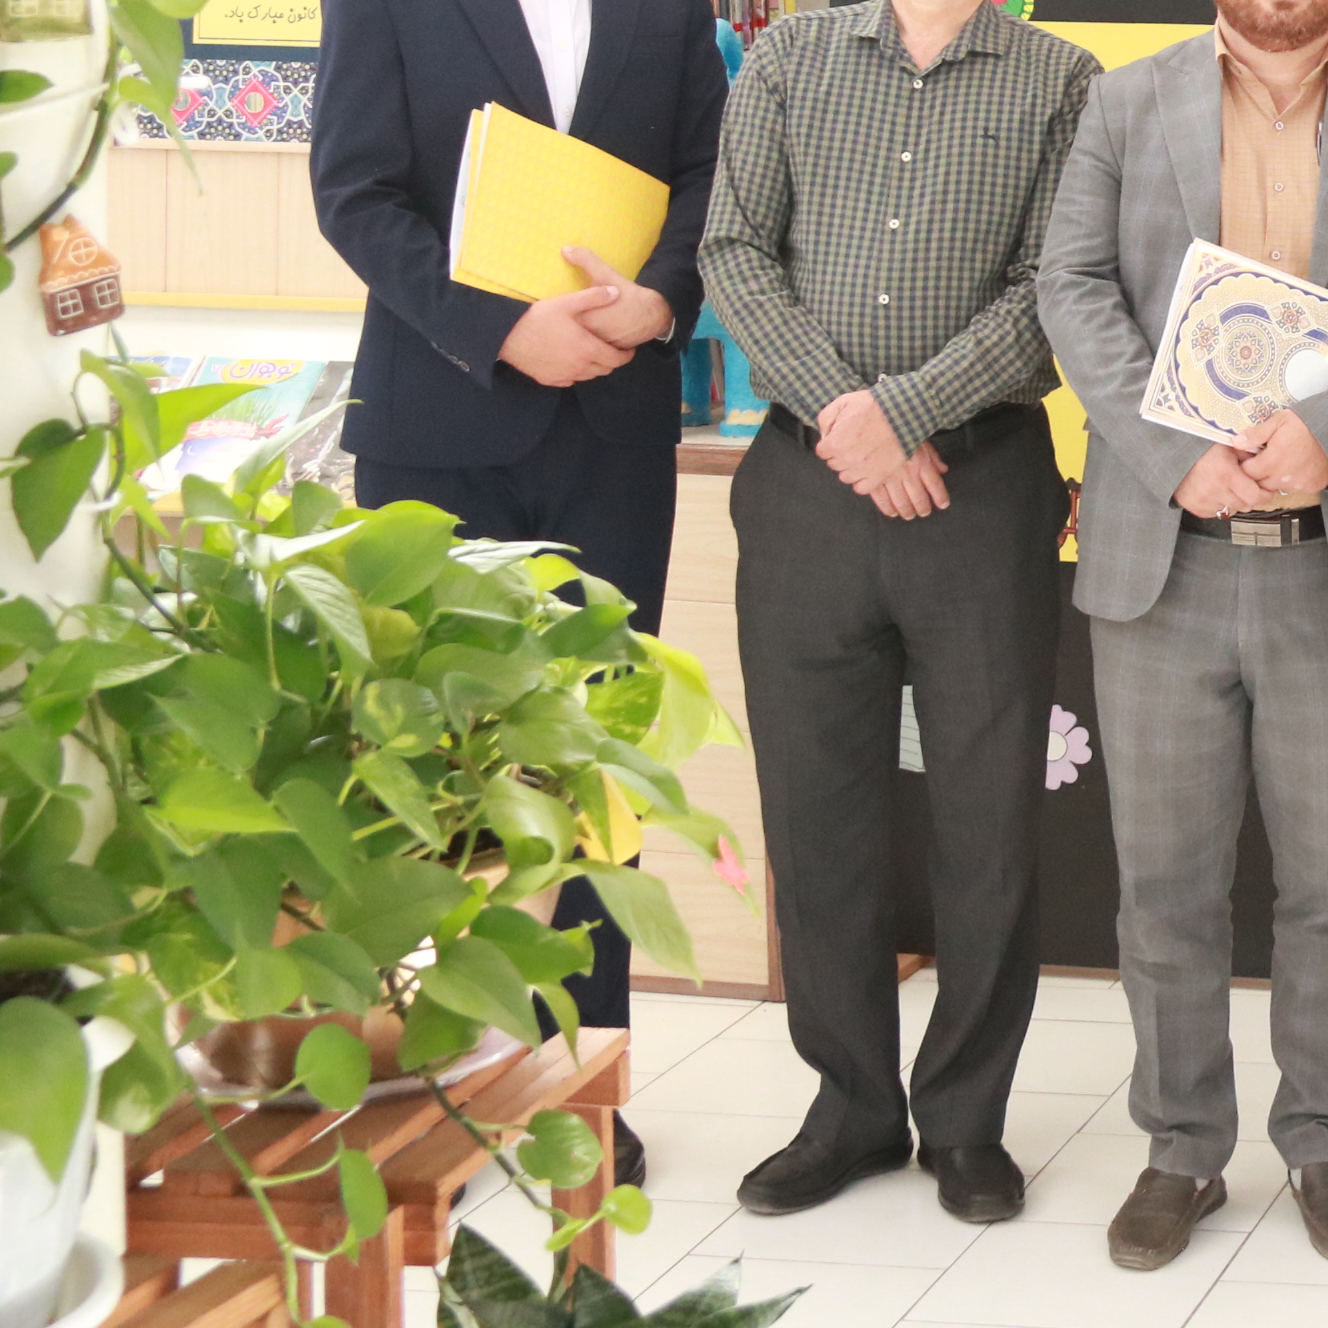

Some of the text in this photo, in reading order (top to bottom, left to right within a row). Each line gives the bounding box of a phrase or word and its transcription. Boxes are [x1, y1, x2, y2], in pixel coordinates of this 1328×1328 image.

[247, 4, 285, 24] مبارک
[287, 5, 319, 24] کانون
[229, 361, 297, 380] نوجوان
